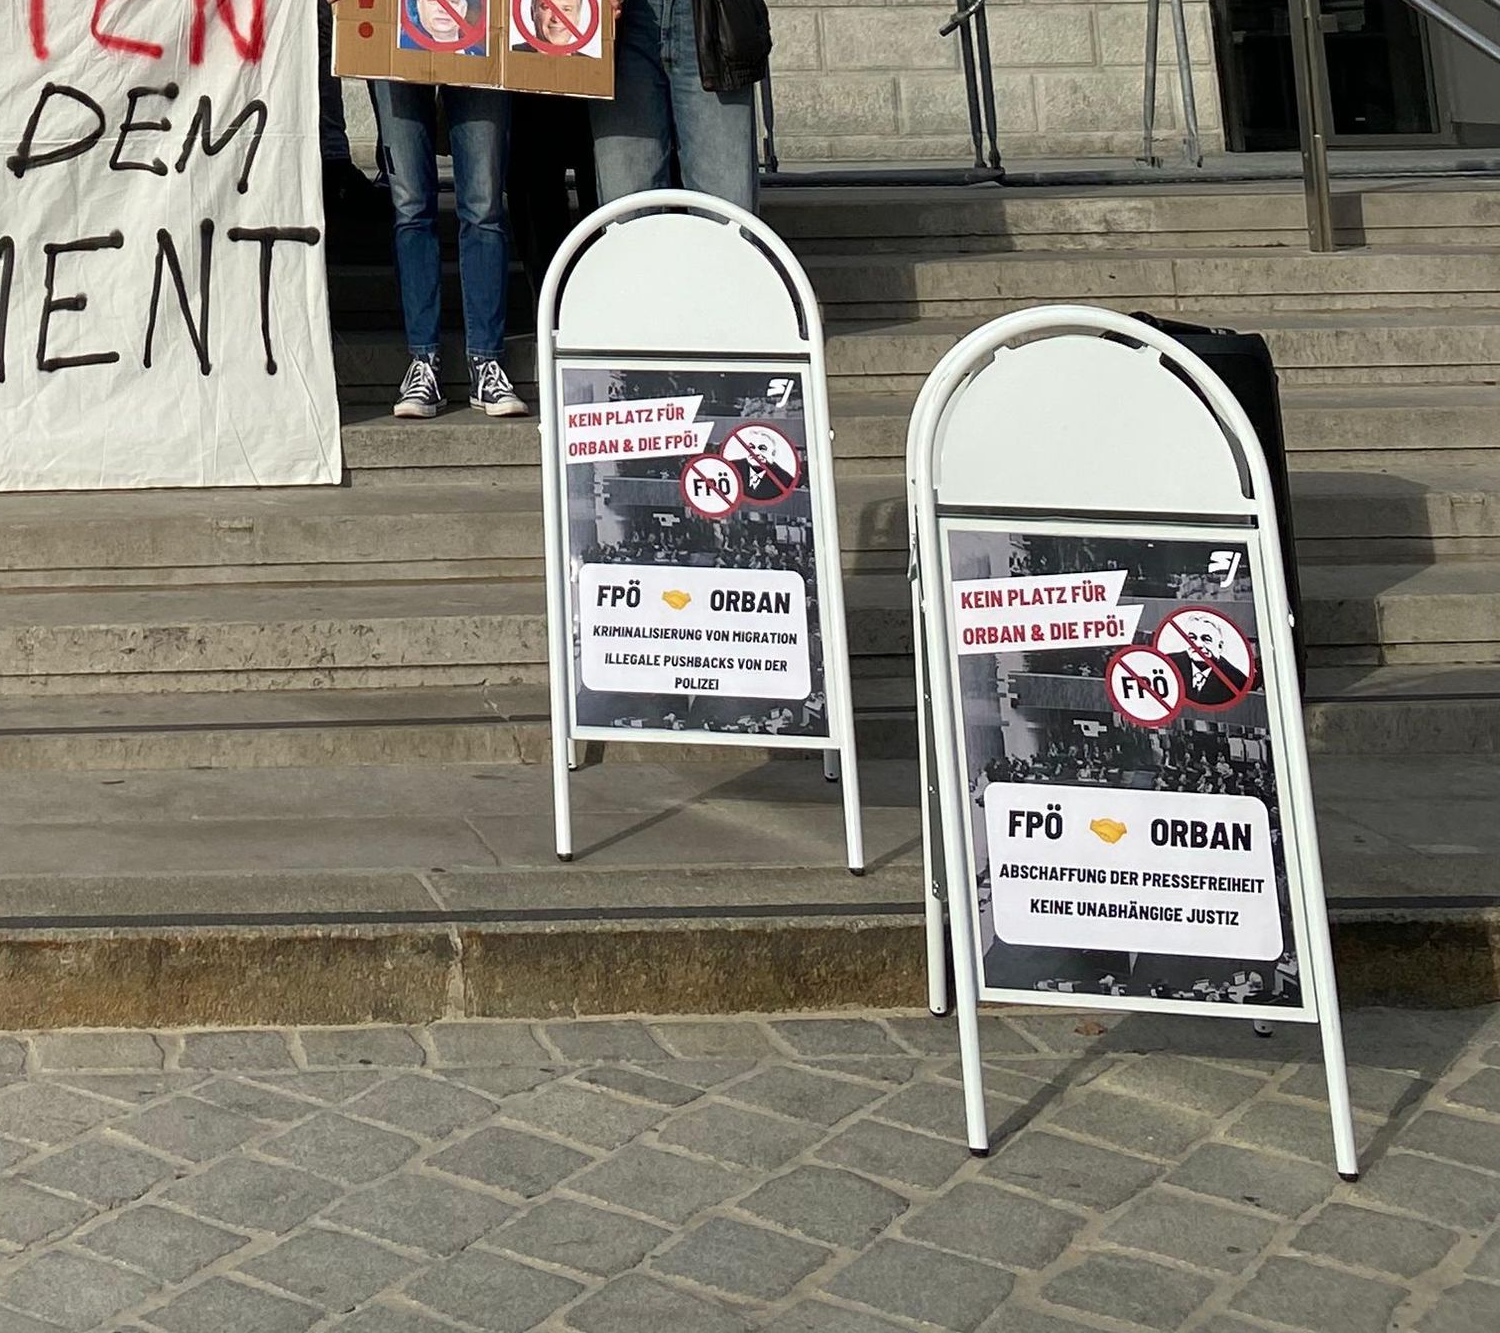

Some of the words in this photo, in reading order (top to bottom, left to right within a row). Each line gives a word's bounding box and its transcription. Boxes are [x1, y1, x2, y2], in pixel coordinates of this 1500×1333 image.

[8, 82, 267, 193] DEM
[568, 413, 601, 428] KEIN
[606, 409, 652, 425] PLATZ
[657, 403, 685, 422] FÜR
[569, 439, 618, 457] ORBAN
[622, 438, 634, 453] &
[638, 436, 661, 451] DIE
[665, 431, 698, 449] FPÖ!
[693, 472, 730, 496] FPÖ
[596, 579, 641, 608] FPÖ
[710, 589, 791, 614] ORBAN
[961, 590, 1002, 609] KEIN
[1008, 585, 1067, 607] PLATZ
[1072, 580, 1106, 602] FÜR
[593, 625, 702, 641] KRIMINALISIERUNG
[705, 630, 730, 642] VON
[732, 630, 798, 645] MIGRATION
[962, 625, 1025, 645] ORBAN
[1031, 623, 1045, 642] &
[1050, 621, 1079, 640] DIE
[1083, 615, 1125, 638] FPÖ!
[604, 653, 661, 667] ILLEGALE
[663, 655, 734, 669] PUSHBACKS
[737, 658, 762, 671] VON
[765, 659, 788, 672] DER
[675, 677, 719, 690] POLIZEI
[1121, 669, 1169, 699] FPÖ
[1008, 803, 1063, 840] FPÖ
[1150, 818, 1252, 852] ORBAN
[999, 864, 1107, 884] ABSCHAFFUNG
[1110, 871, 1139, 886] DER
[1142, 872, 1264, 893] PRESSEFREIHEIT
[1030, 898, 1074, 916] KEINE
[1077, 900, 1183, 923] UNABHÄNGIGE
[1186, 909, 1240, 926] JUSTIZ
